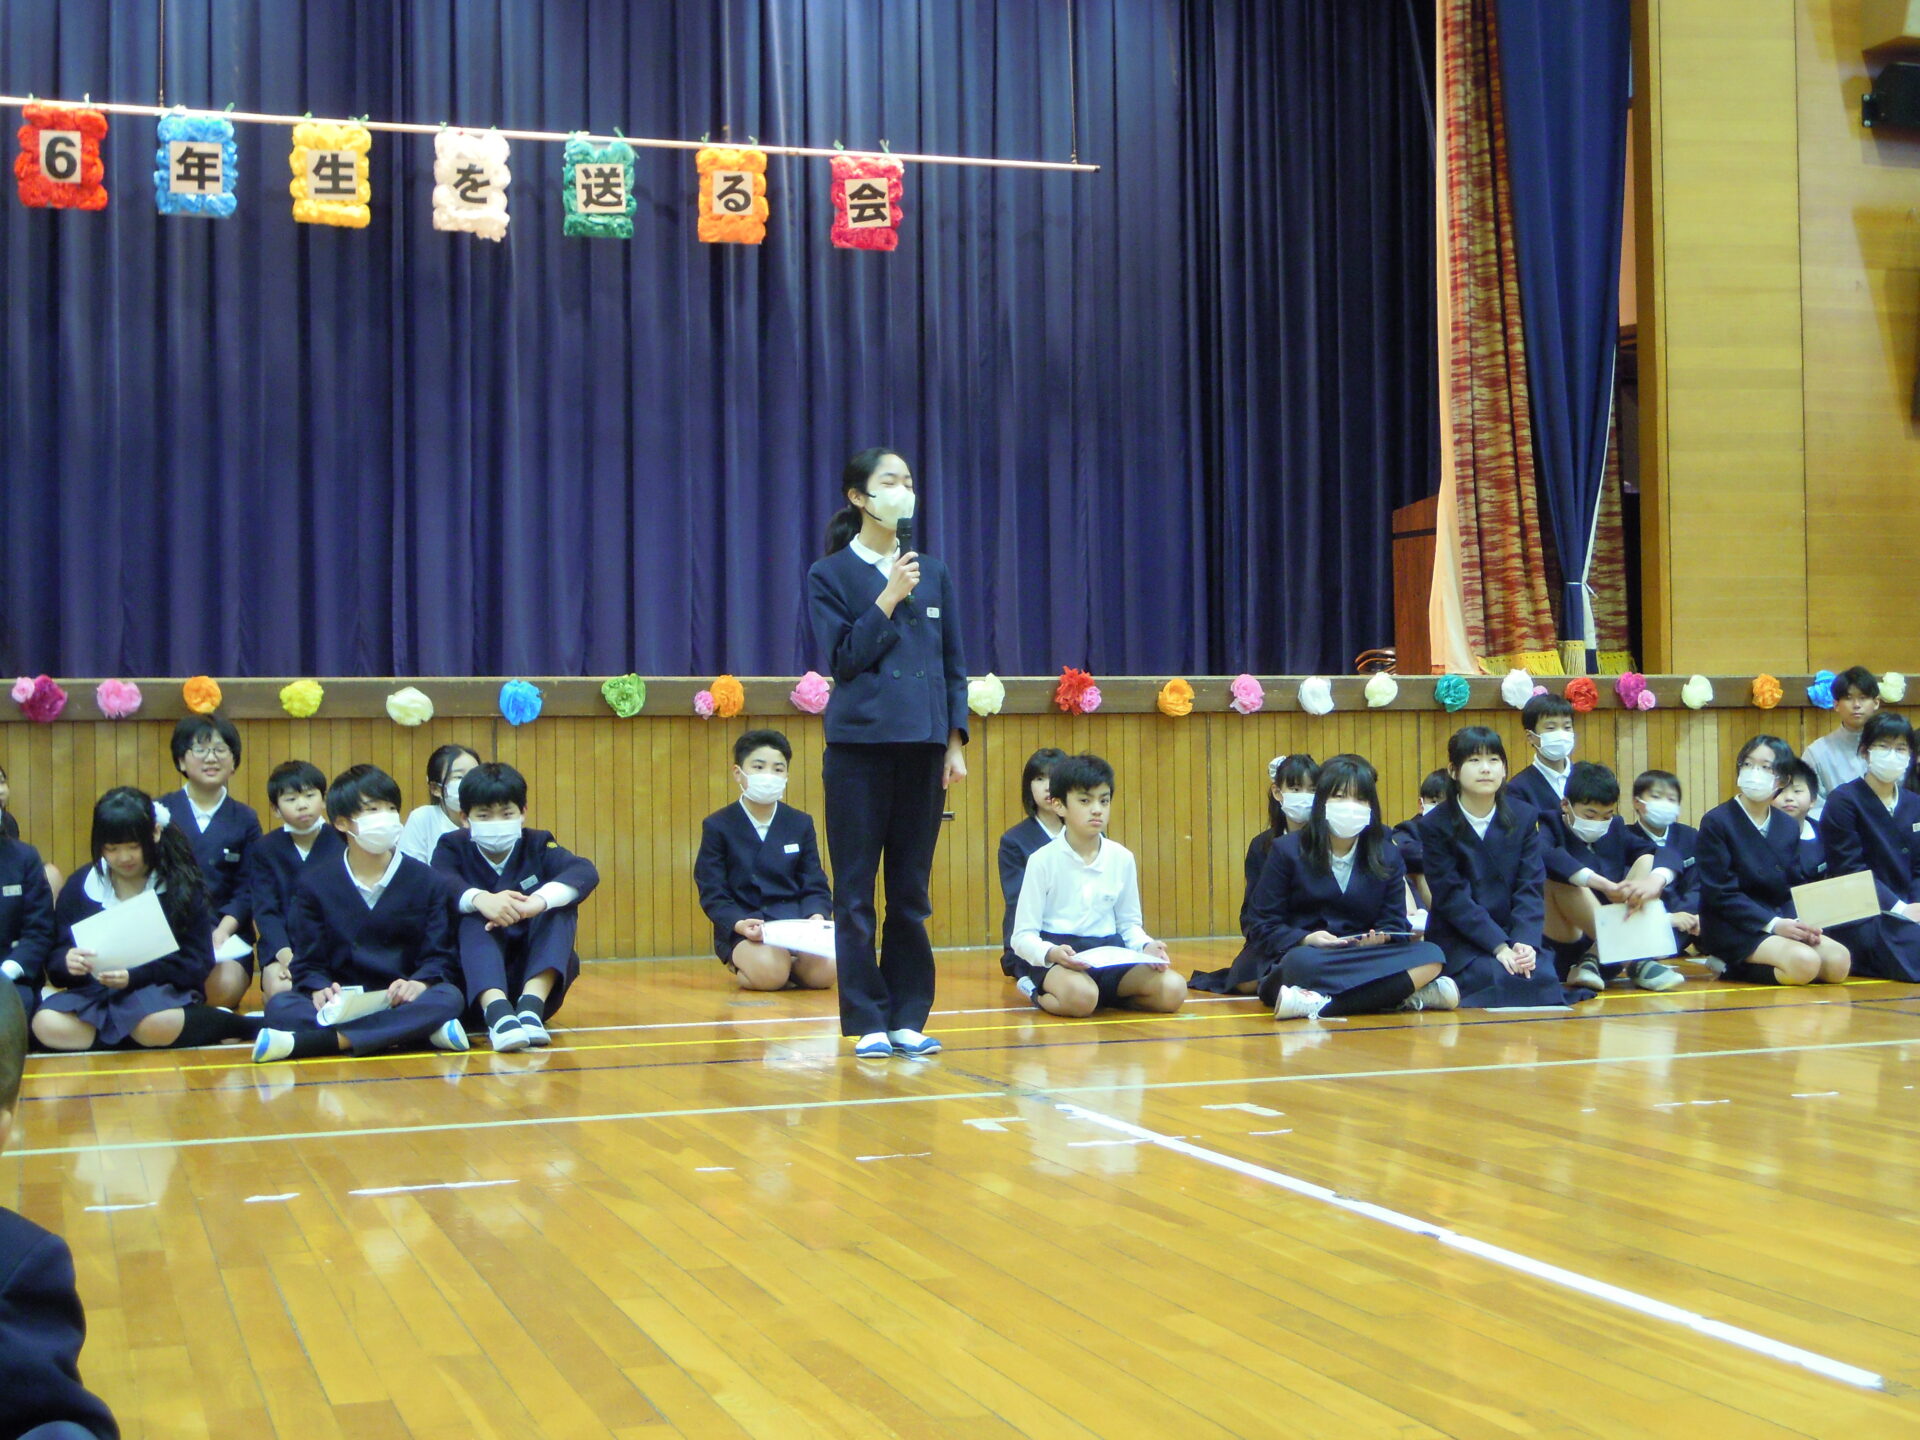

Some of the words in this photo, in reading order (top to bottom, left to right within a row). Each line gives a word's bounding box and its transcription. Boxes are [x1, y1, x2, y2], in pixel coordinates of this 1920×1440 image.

[44, 136, 889, 224] 6年生を送る会
